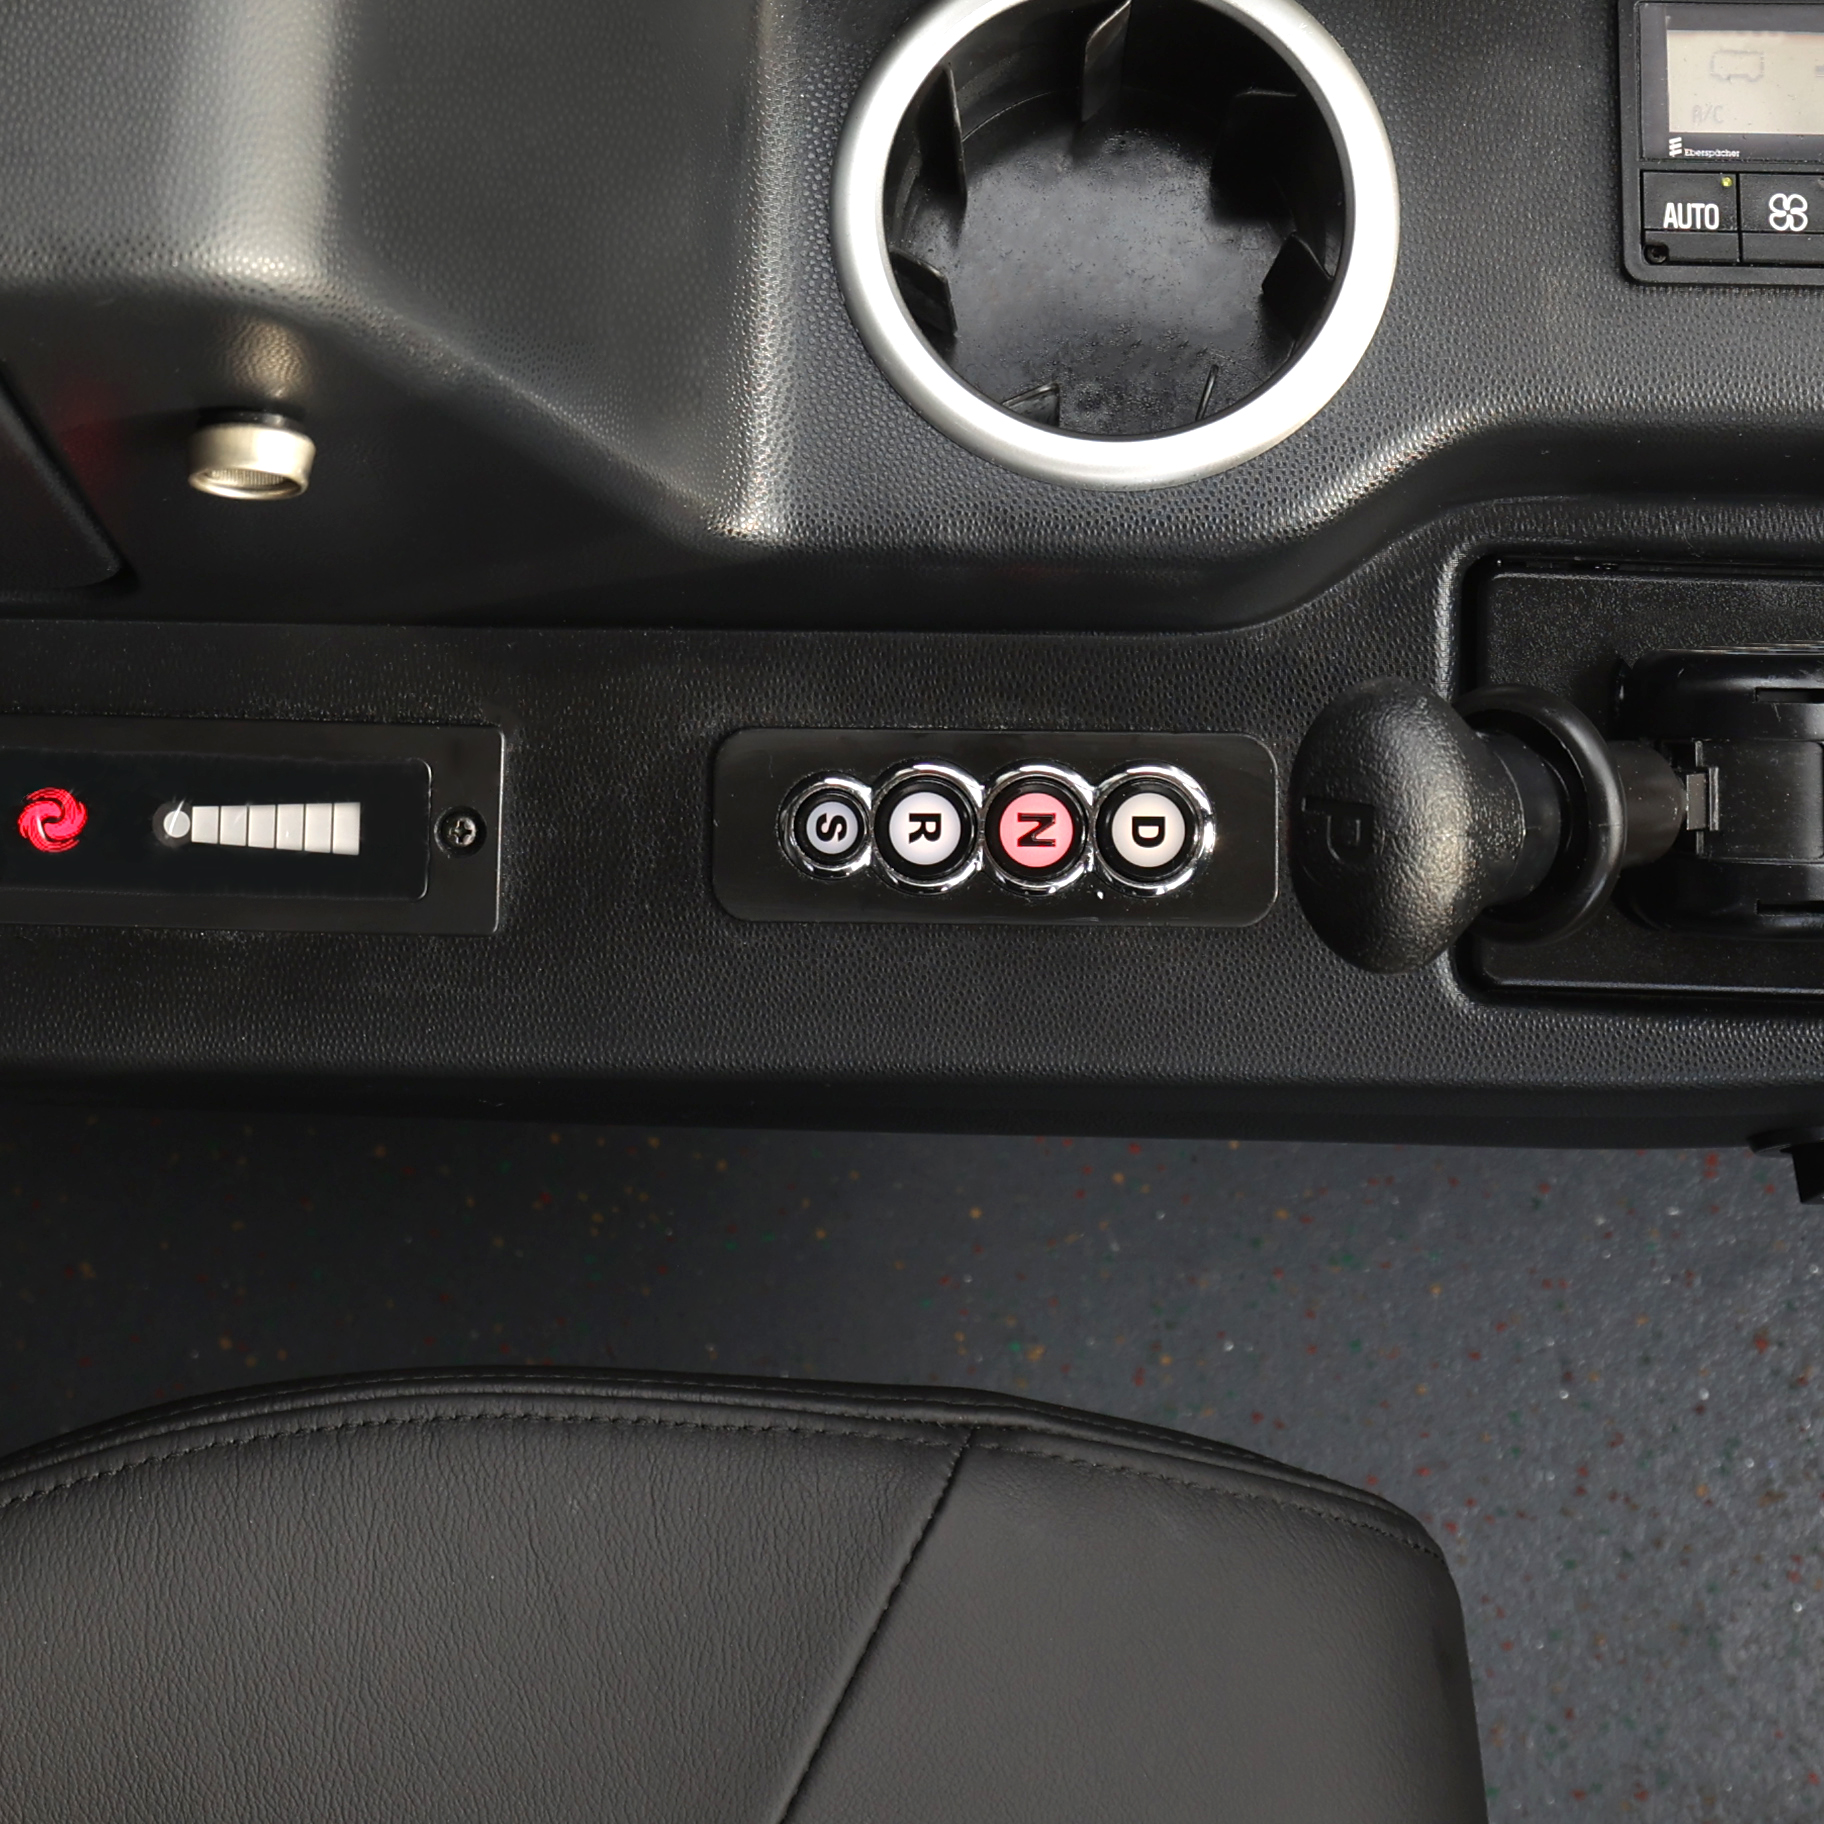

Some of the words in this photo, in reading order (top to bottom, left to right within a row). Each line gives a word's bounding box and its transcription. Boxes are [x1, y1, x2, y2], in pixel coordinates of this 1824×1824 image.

[1691, 104, 1725, 124] A/C
[1663, 202, 1720, 230] AUTO
[815, 812, 848, 843] S
[908, 812, 942, 845] R
[1016, 812, 1057, 847] N
[1131, 815, 1166, 849] D
[1301, 797, 1374, 861] P
